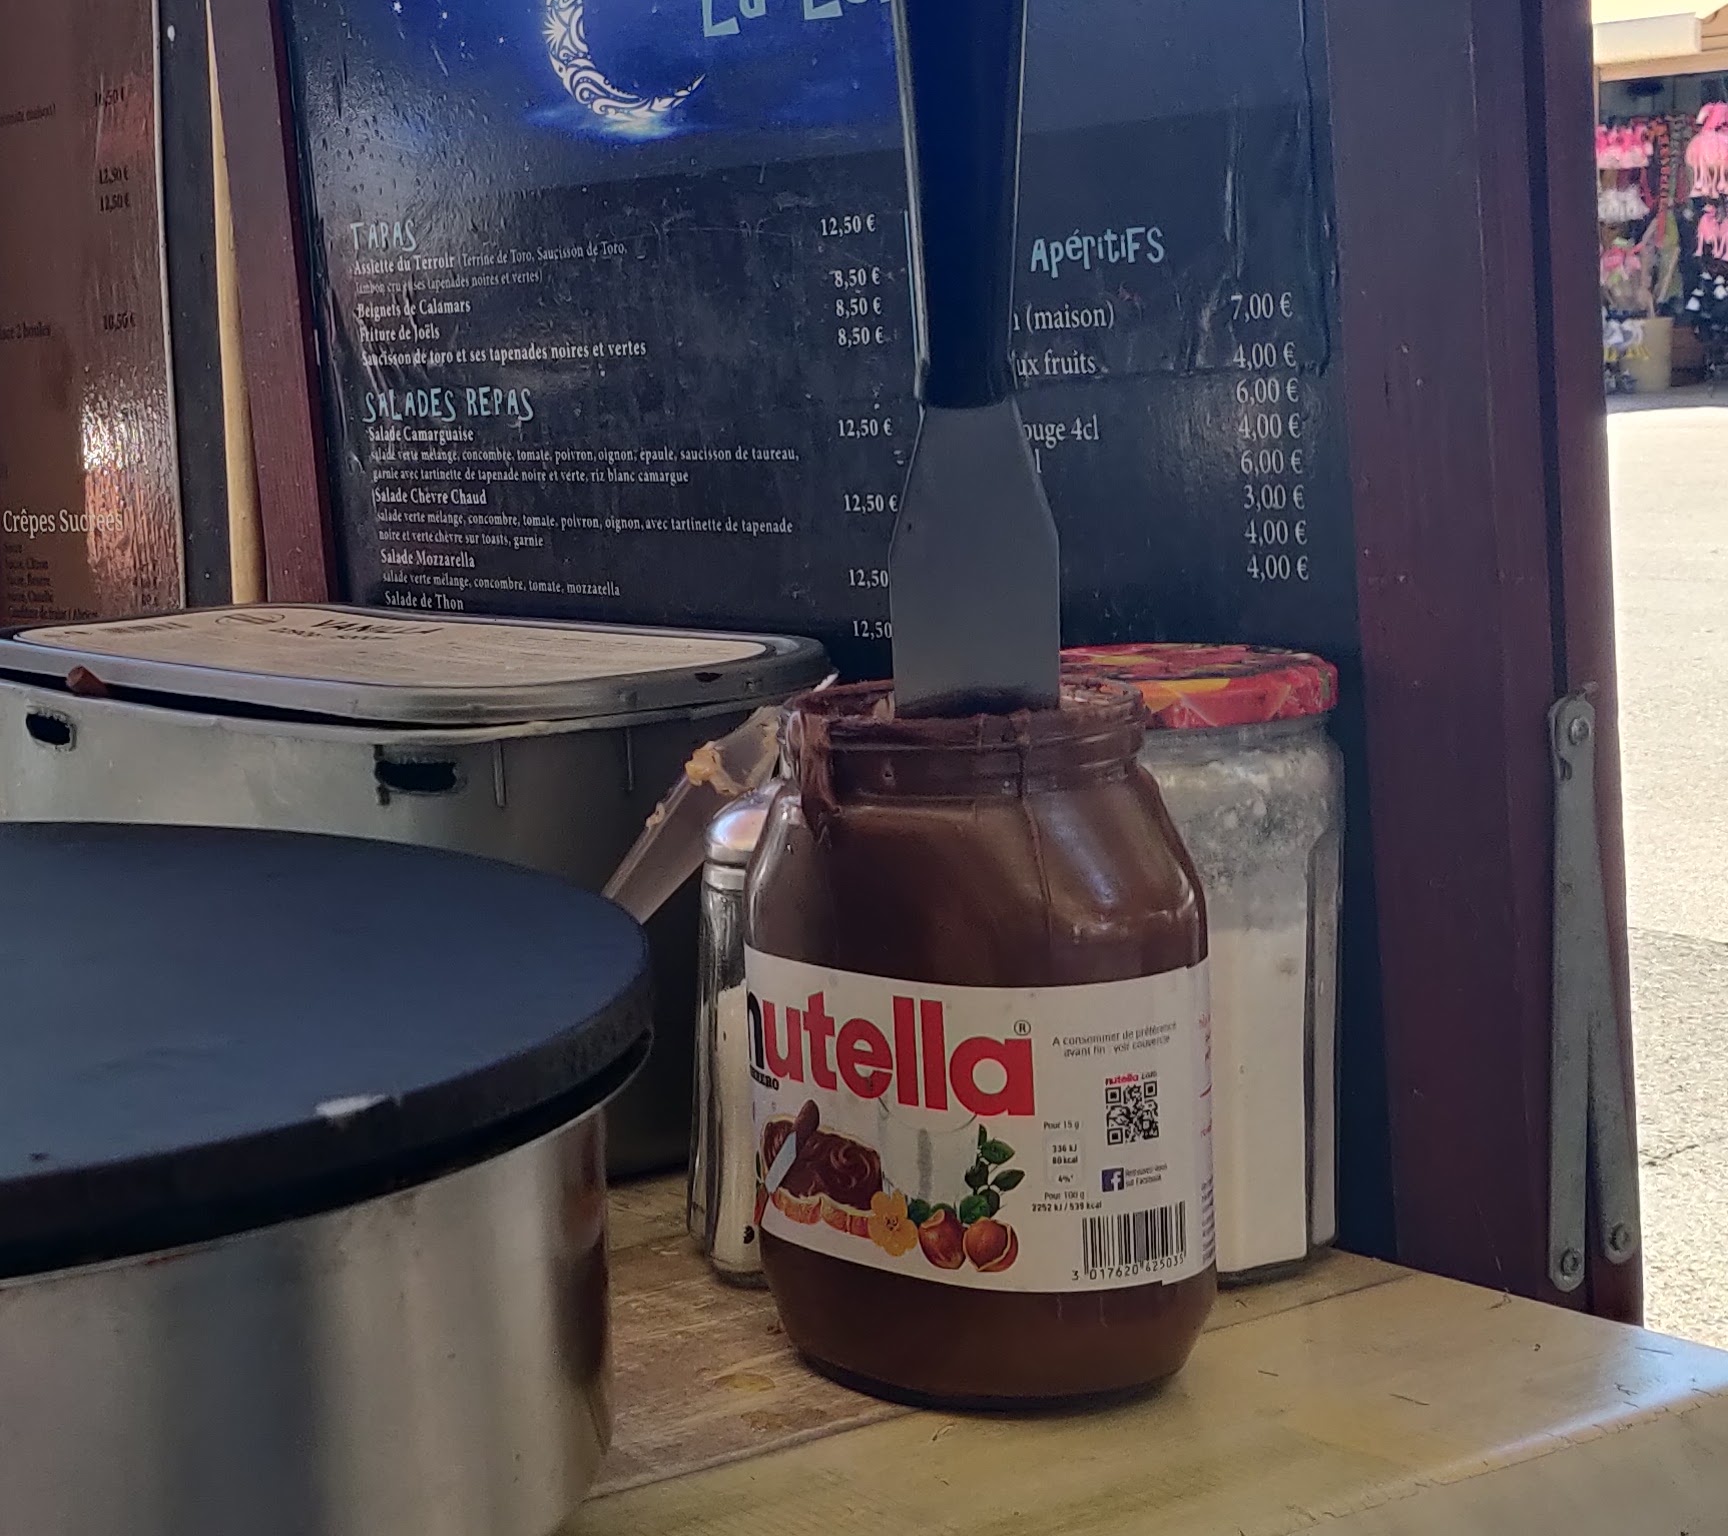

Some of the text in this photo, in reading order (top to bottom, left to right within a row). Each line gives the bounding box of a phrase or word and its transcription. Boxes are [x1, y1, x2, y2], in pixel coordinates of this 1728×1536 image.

[350, 220, 418, 252] TAPAS
[397, 257, 412, 272] du
[357, 299, 472, 322] Beignets de Calamars
[1026, 291, 1294, 332] (maison) 7,00 €
[360, 327, 396, 344] Friture
[398, 326, 412, 342] de
[361, 340, 647, 367] Saucisson de toro et ses tapenades noires et vertes
[1043, 348, 1097, 375] fruits
[1233, 343, 1278, 371] 4,00
[1283, 341, 1297, 367] €
[362, 386, 534, 423] SALADES REPAS
[368, 425, 474, 445] Salade Camarguaise
[1070, 413, 1100, 440] 4cl
[680, 446, 732, 461] saucisson
[735, 445, 749, 461] de
[751, 447, 800, 462] taureau,
[375, 488, 408, 504] Salade
[451, 489, 488, 505] Chaud
[3, 509, 56, 539] Crêpes
[380, 549, 476, 568] Salade Mozzarella
[566, 581, 621, 597] mozzarella
[385, 591, 465, 611] Salade de Thon
[747, 991, 1036, 1118] nutella
[1072, 1270, 1079, 1281] 3
[1090, 1265, 1139, 1280] 017620
